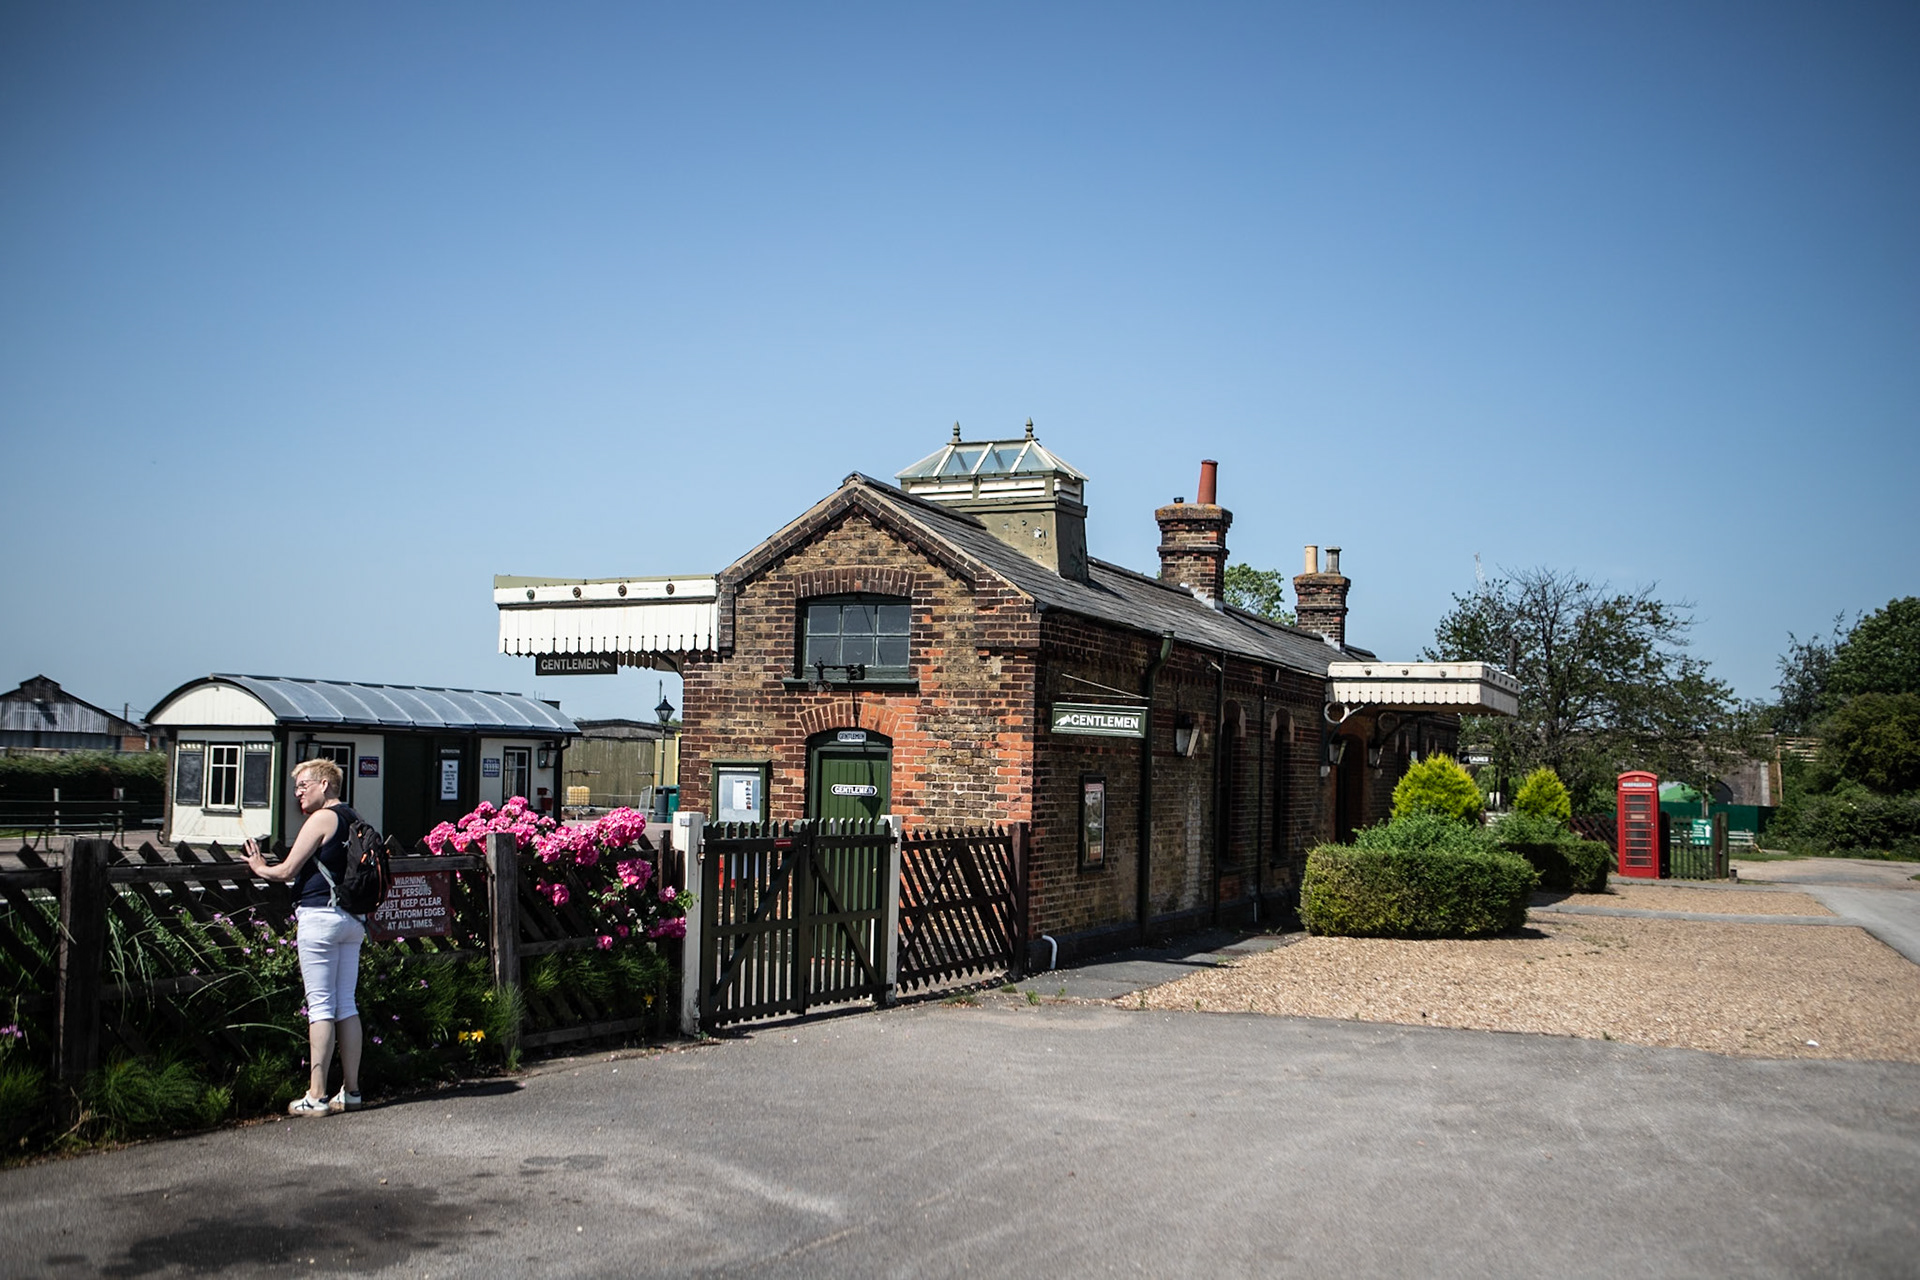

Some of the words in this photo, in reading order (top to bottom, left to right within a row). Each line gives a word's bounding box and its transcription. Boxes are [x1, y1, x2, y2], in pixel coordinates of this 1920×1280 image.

[541, 658, 599, 670] GENTLEMEN
[1070, 714, 1139, 729] GENTLEMEN
[839, 732, 865, 740] GENTLEMEN
[834, 786, 874, 794] GENTLEMEN
[394, 876, 426, 886] WARNING
[387, 889, 400, 898] ALL
[402, 886, 432, 897] PERSONS
[379, 899, 399, 909] MUST
[401, 898, 418, 908] KEEP
[420, 897, 442, 906] CLEAR
[374, 912, 384, 920] OF
[385, 909, 423, 920] PLATFORM
[424, 907, 446, 916] EDGES
[387, 921, 397, 930] AT
[398, 919, 411, 929] ALL
[413, 919, 435, 928] TIMES.
